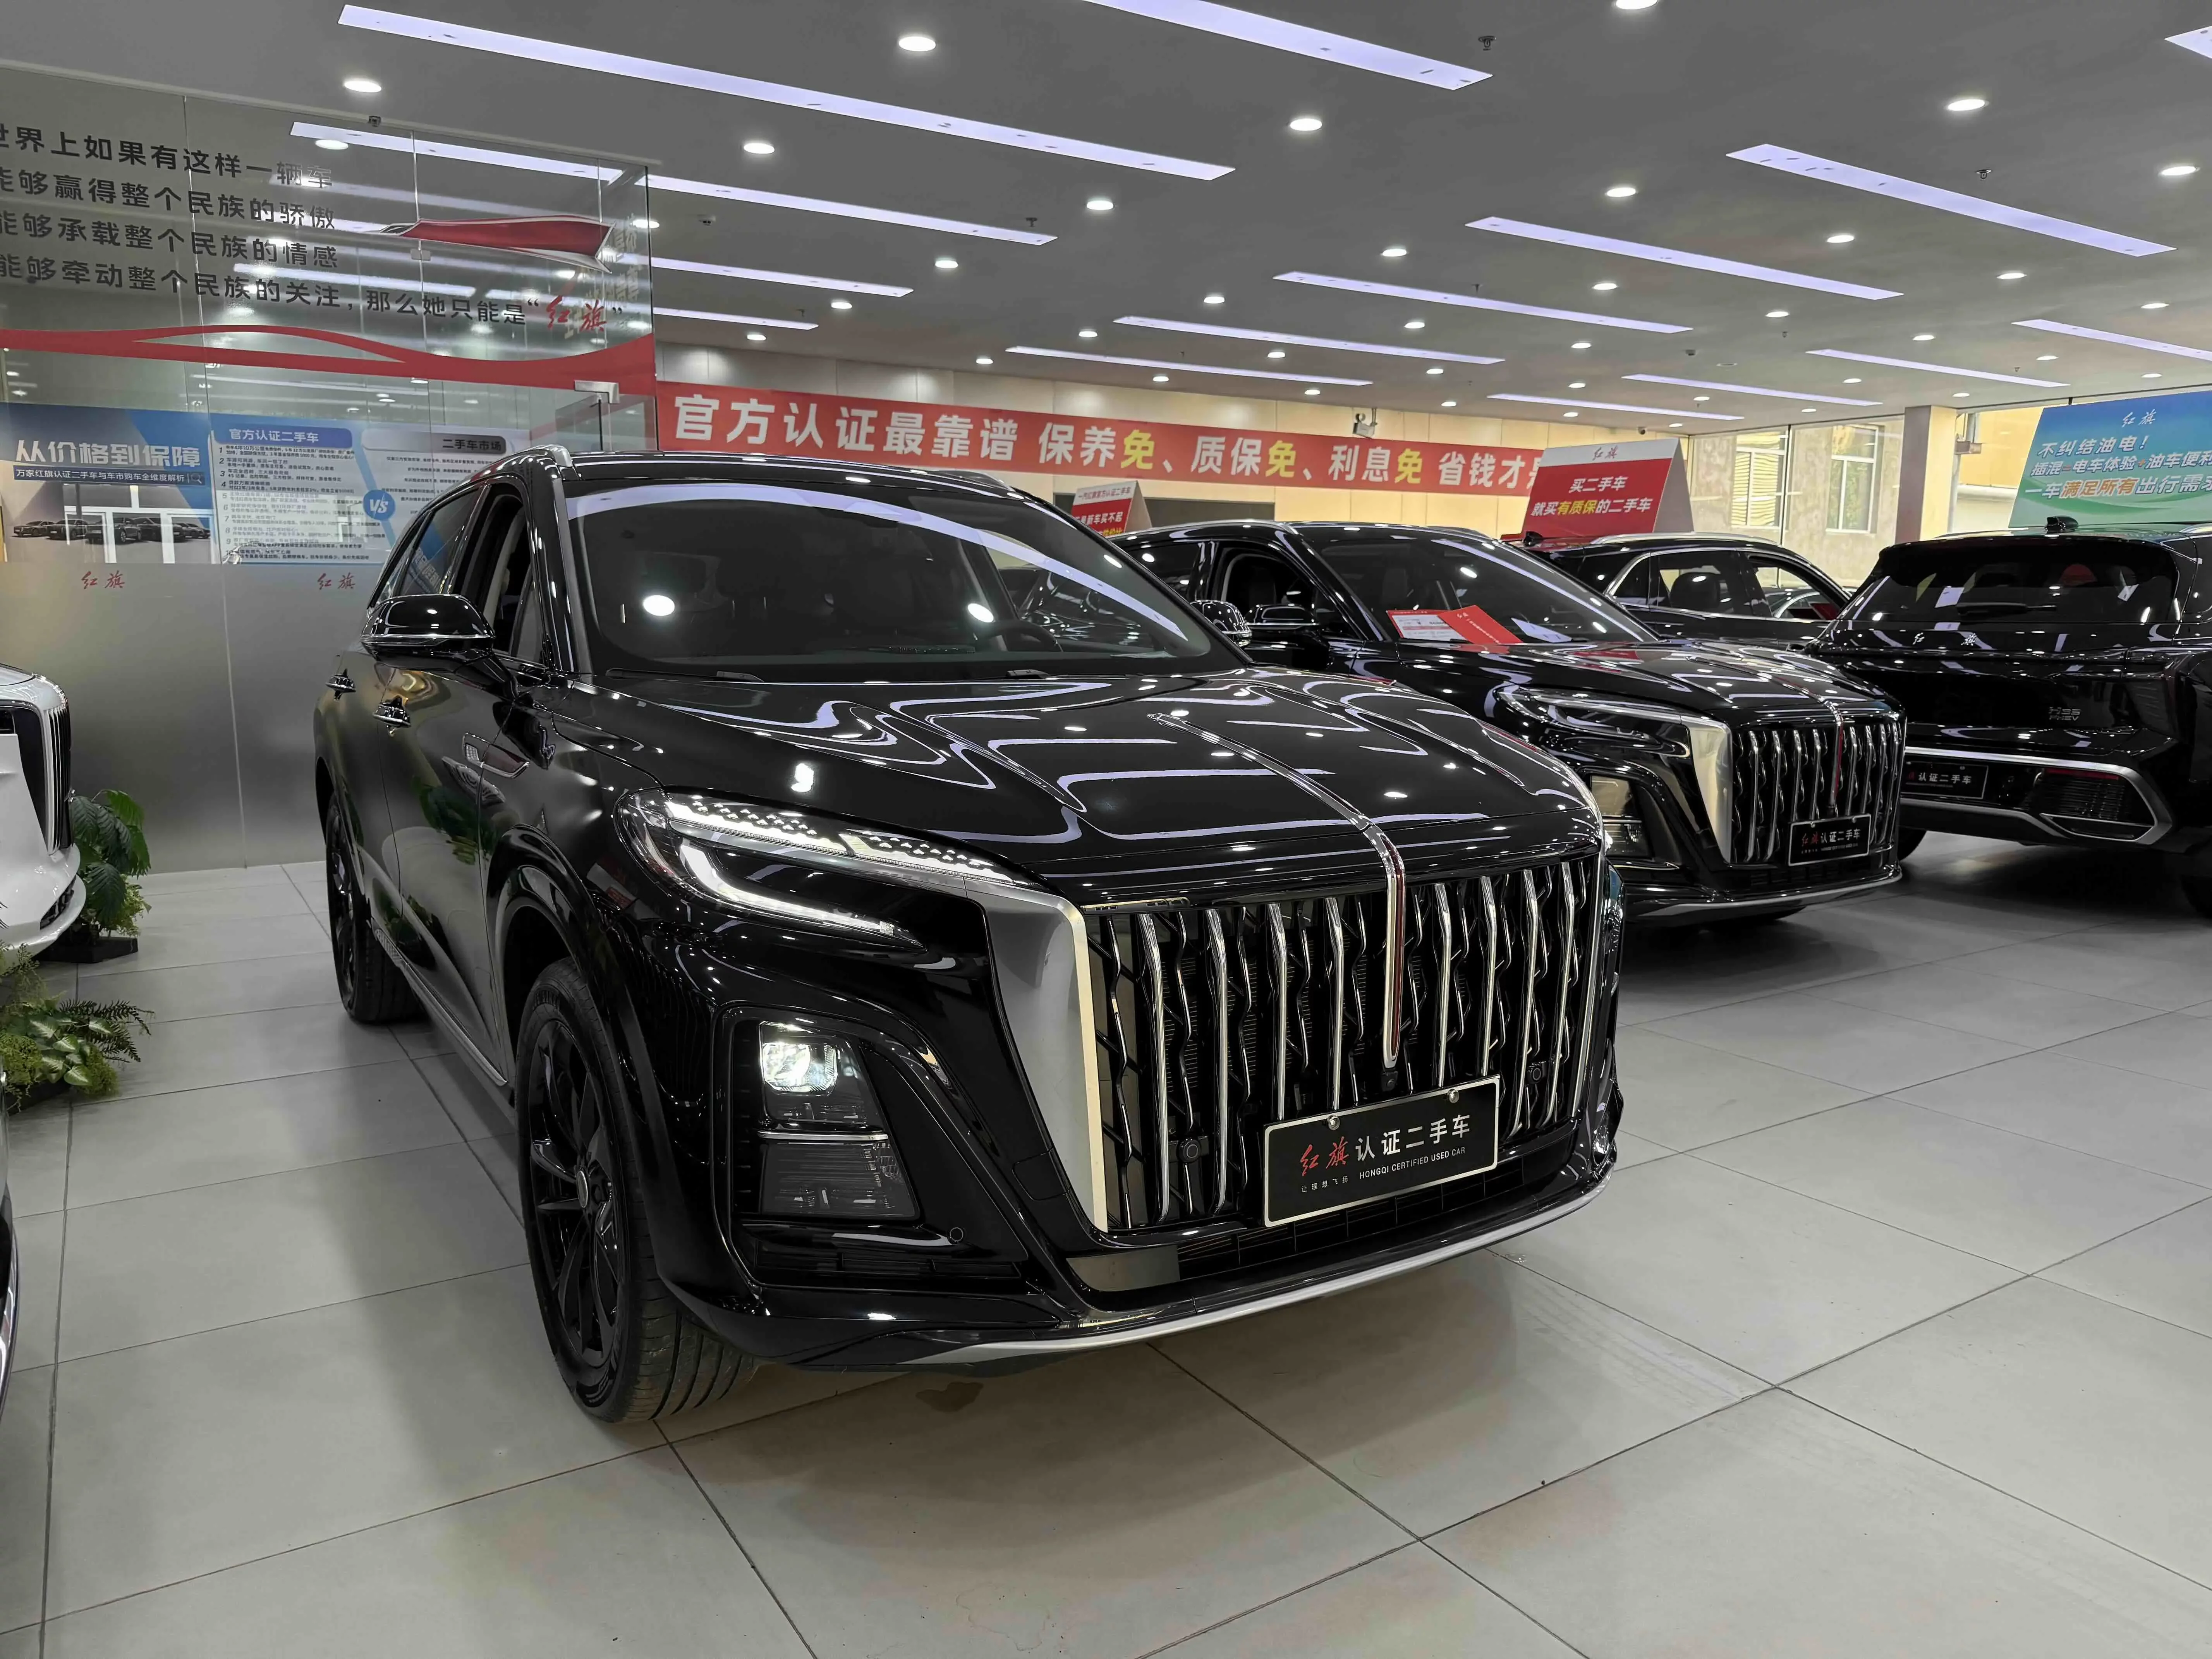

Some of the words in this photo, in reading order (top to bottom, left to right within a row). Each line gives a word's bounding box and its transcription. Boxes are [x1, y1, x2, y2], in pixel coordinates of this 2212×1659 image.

[229, 428, 319, 444] 官方认证二手车
[674, 394, 1018, 461] 官方认证最靠谱
[16, 440, 201, 467] 从价格到保障
[443, 439, 501, 451] 二手车市场
[1569, 476, 1628, 493] 买二手车
[369, 499, 388, 513] VS
[1530, 497, 1653, 517] 就买有质保的二手车
[82, 570, 125, 589] 红旗
[317, 573, 356, 590] 红旗
[1909, 771, 1972, 785] 认证二手车
[1360, 1166, 1389, 1179] HONGQI
[1391, 1156, 1428, 1171] CERTIFIED
[1431, 1151, 1449, 1161] USED
[1452, 1147, 1465, 1156] CAR
